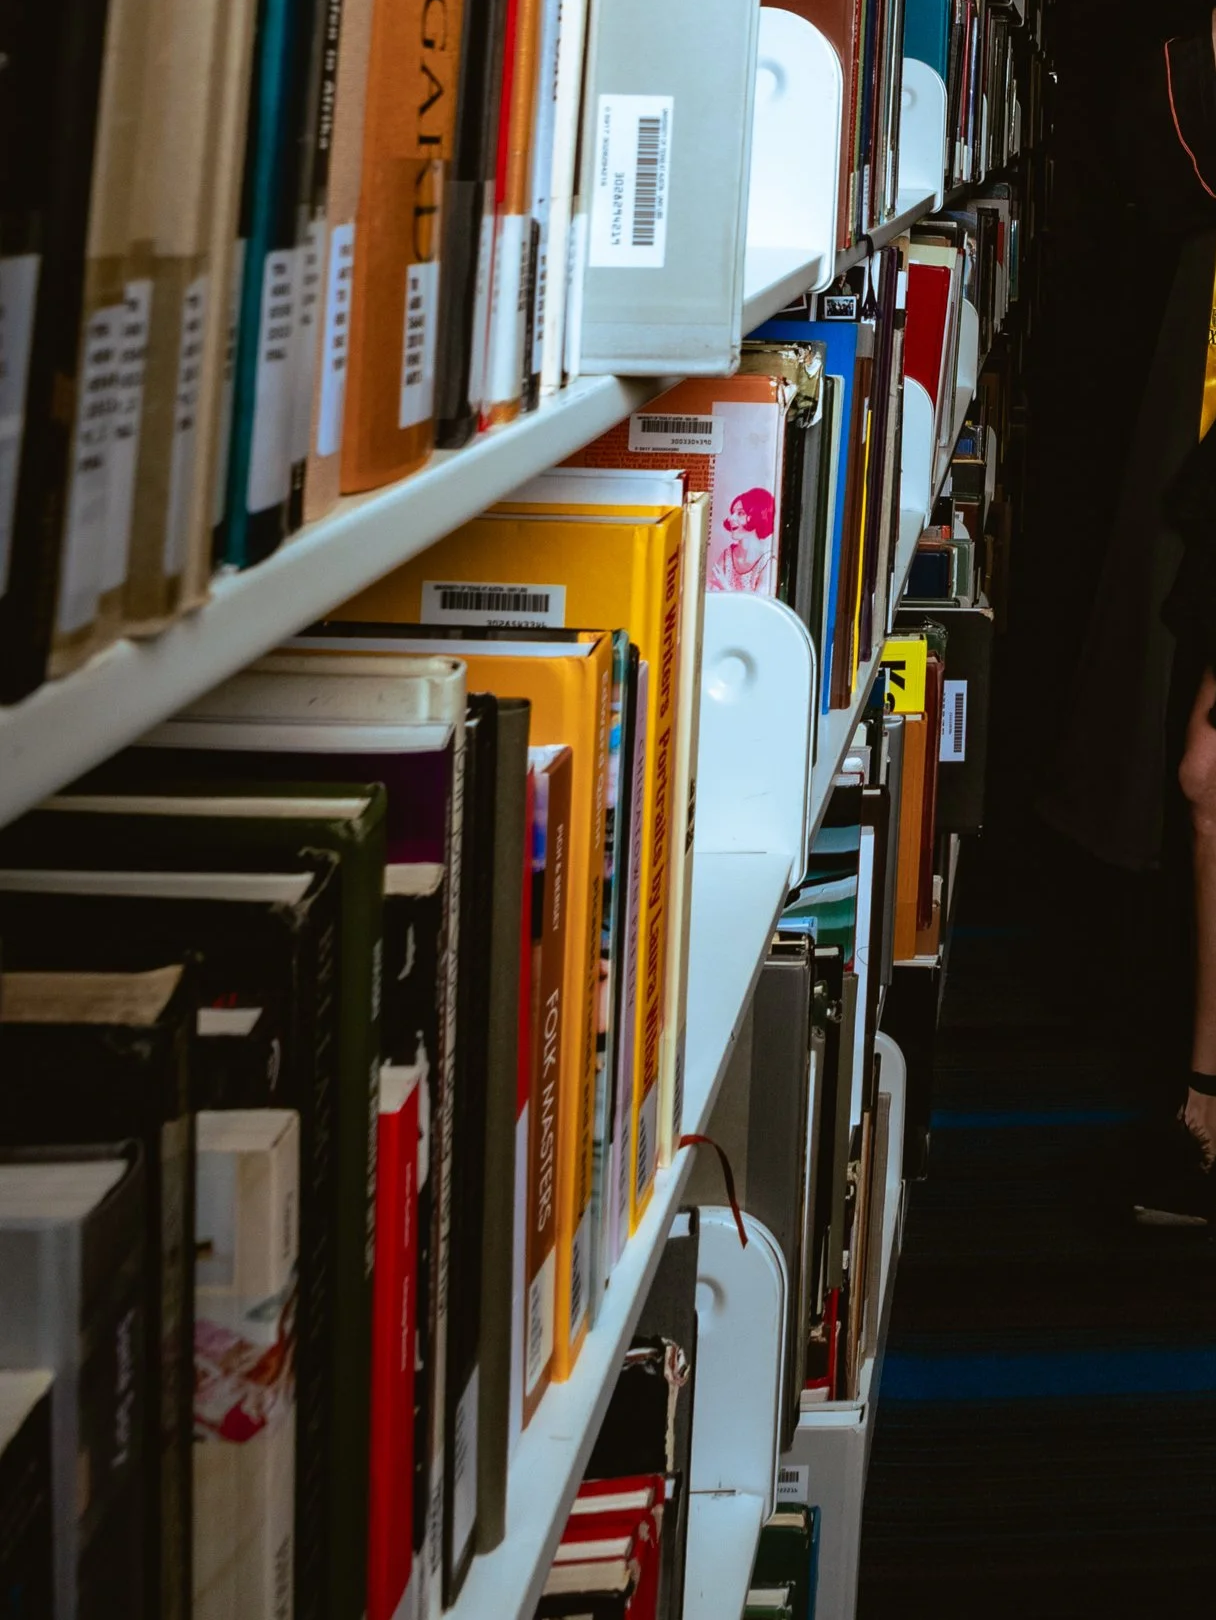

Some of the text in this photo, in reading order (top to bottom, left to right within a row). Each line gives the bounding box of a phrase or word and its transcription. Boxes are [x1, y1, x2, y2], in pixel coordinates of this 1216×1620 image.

[319, 79, 336, 151] Afrika
[324, 48, 338, 72] in
[642, 543, 680, 1096] The Writers Portraits by Laura Wilson
[537, 988, 559, 1234] FOLK MASTERS
